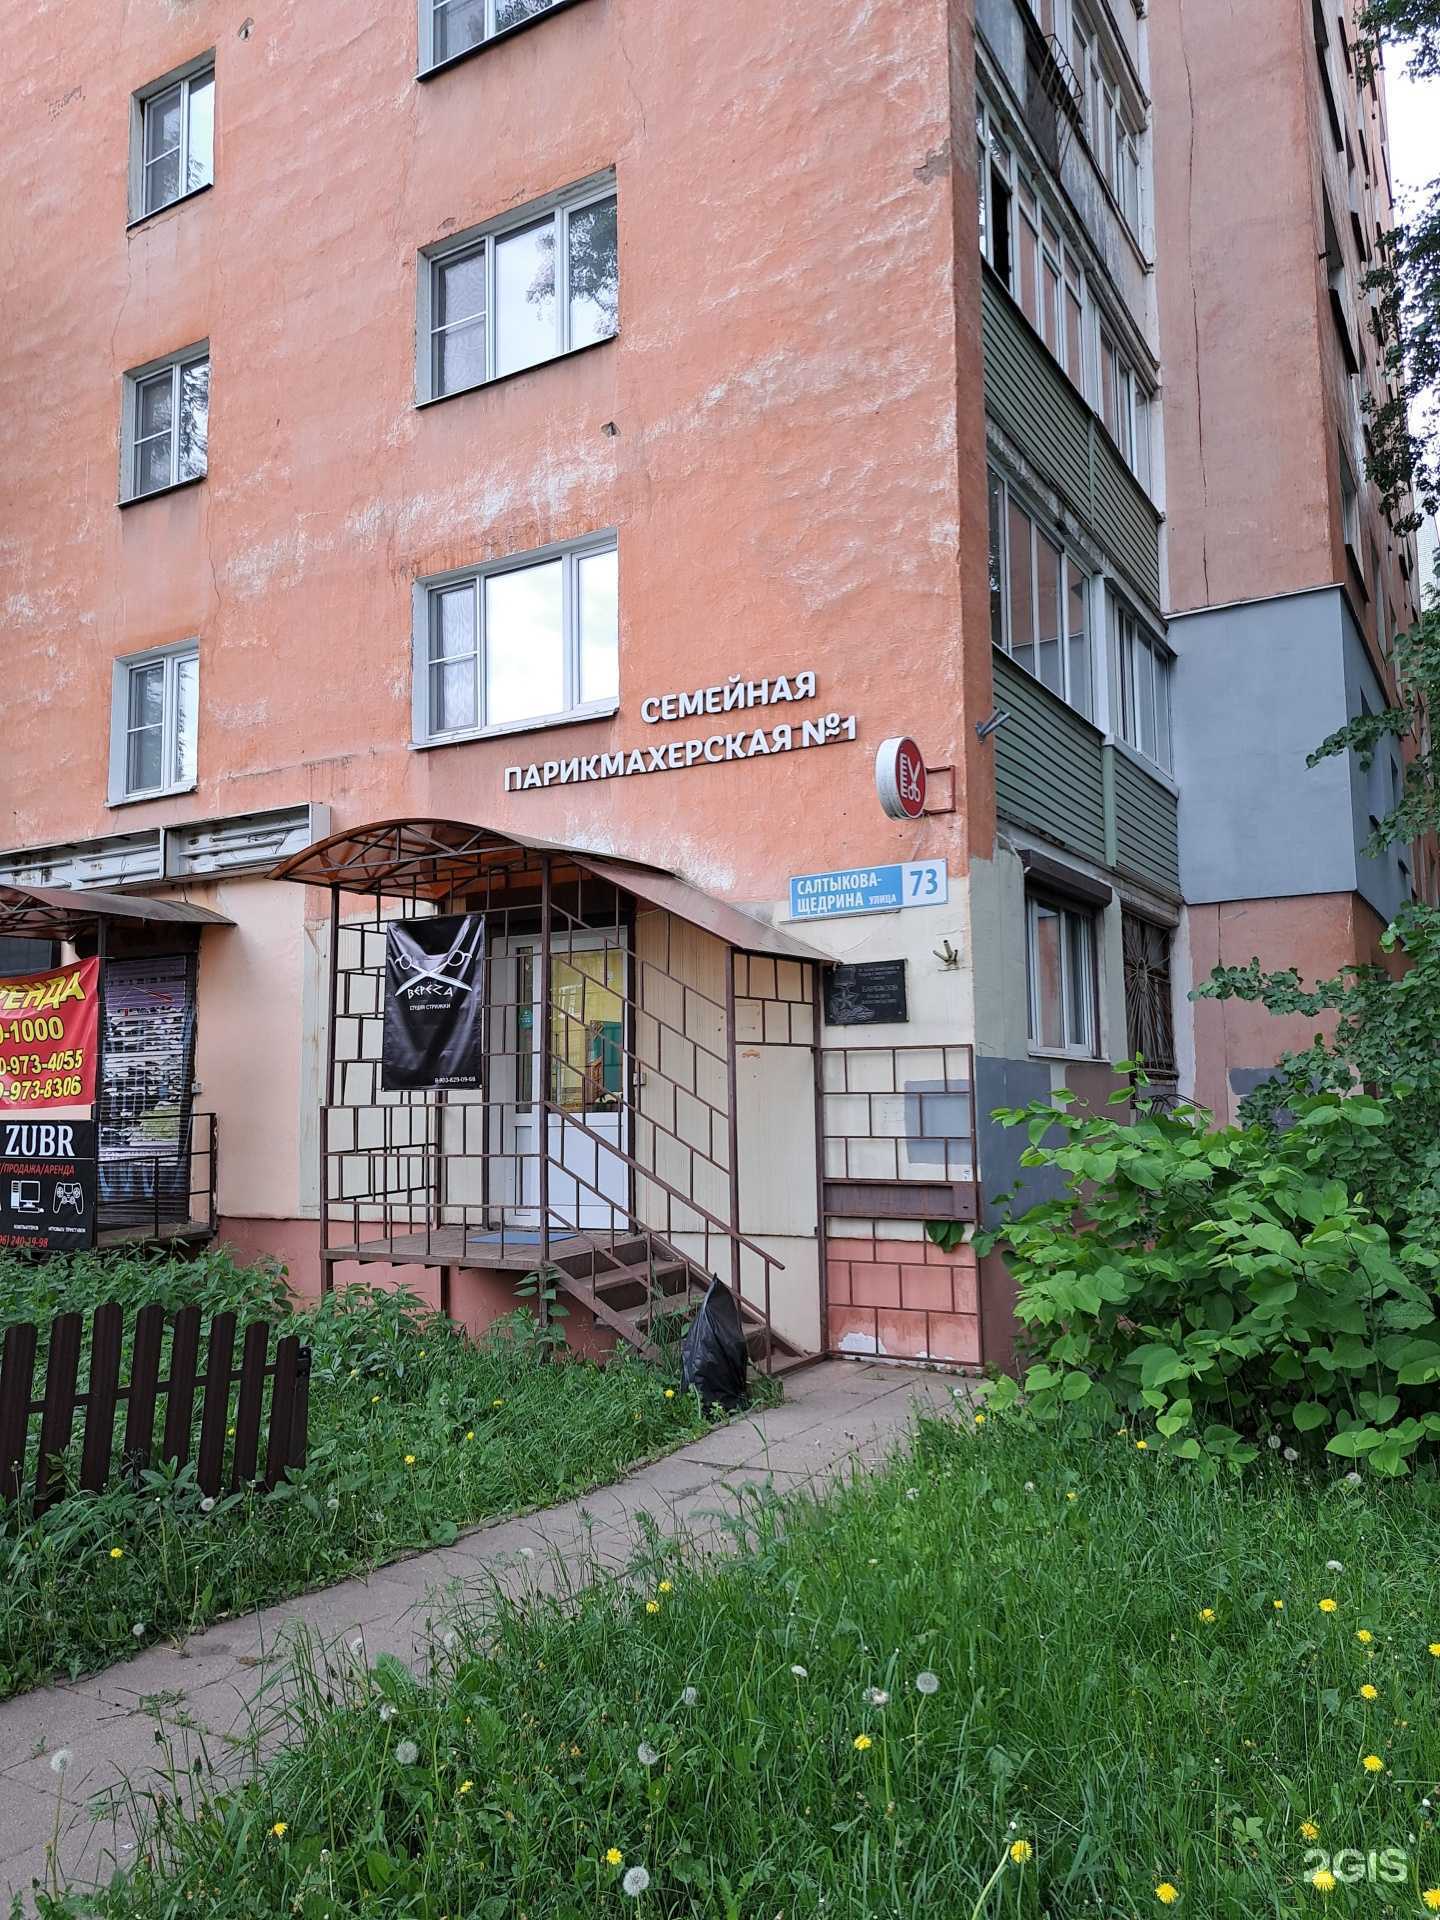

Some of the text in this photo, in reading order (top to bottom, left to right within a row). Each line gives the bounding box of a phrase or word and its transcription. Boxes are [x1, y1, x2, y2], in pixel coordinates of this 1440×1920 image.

[640, 671, 816, 723] СЕМЕЙНАЯ
[504, 712, 857, 791] ПАРИКМАХЕРСКАЯ №1
[797, 872, 882, 895] САЛТЫКОВА-
[910, 868, 938, 896] 73
[798, 892, 864, 915] ЩЕДРИНА
[5, 1125, 75, 1157] ZUBR
